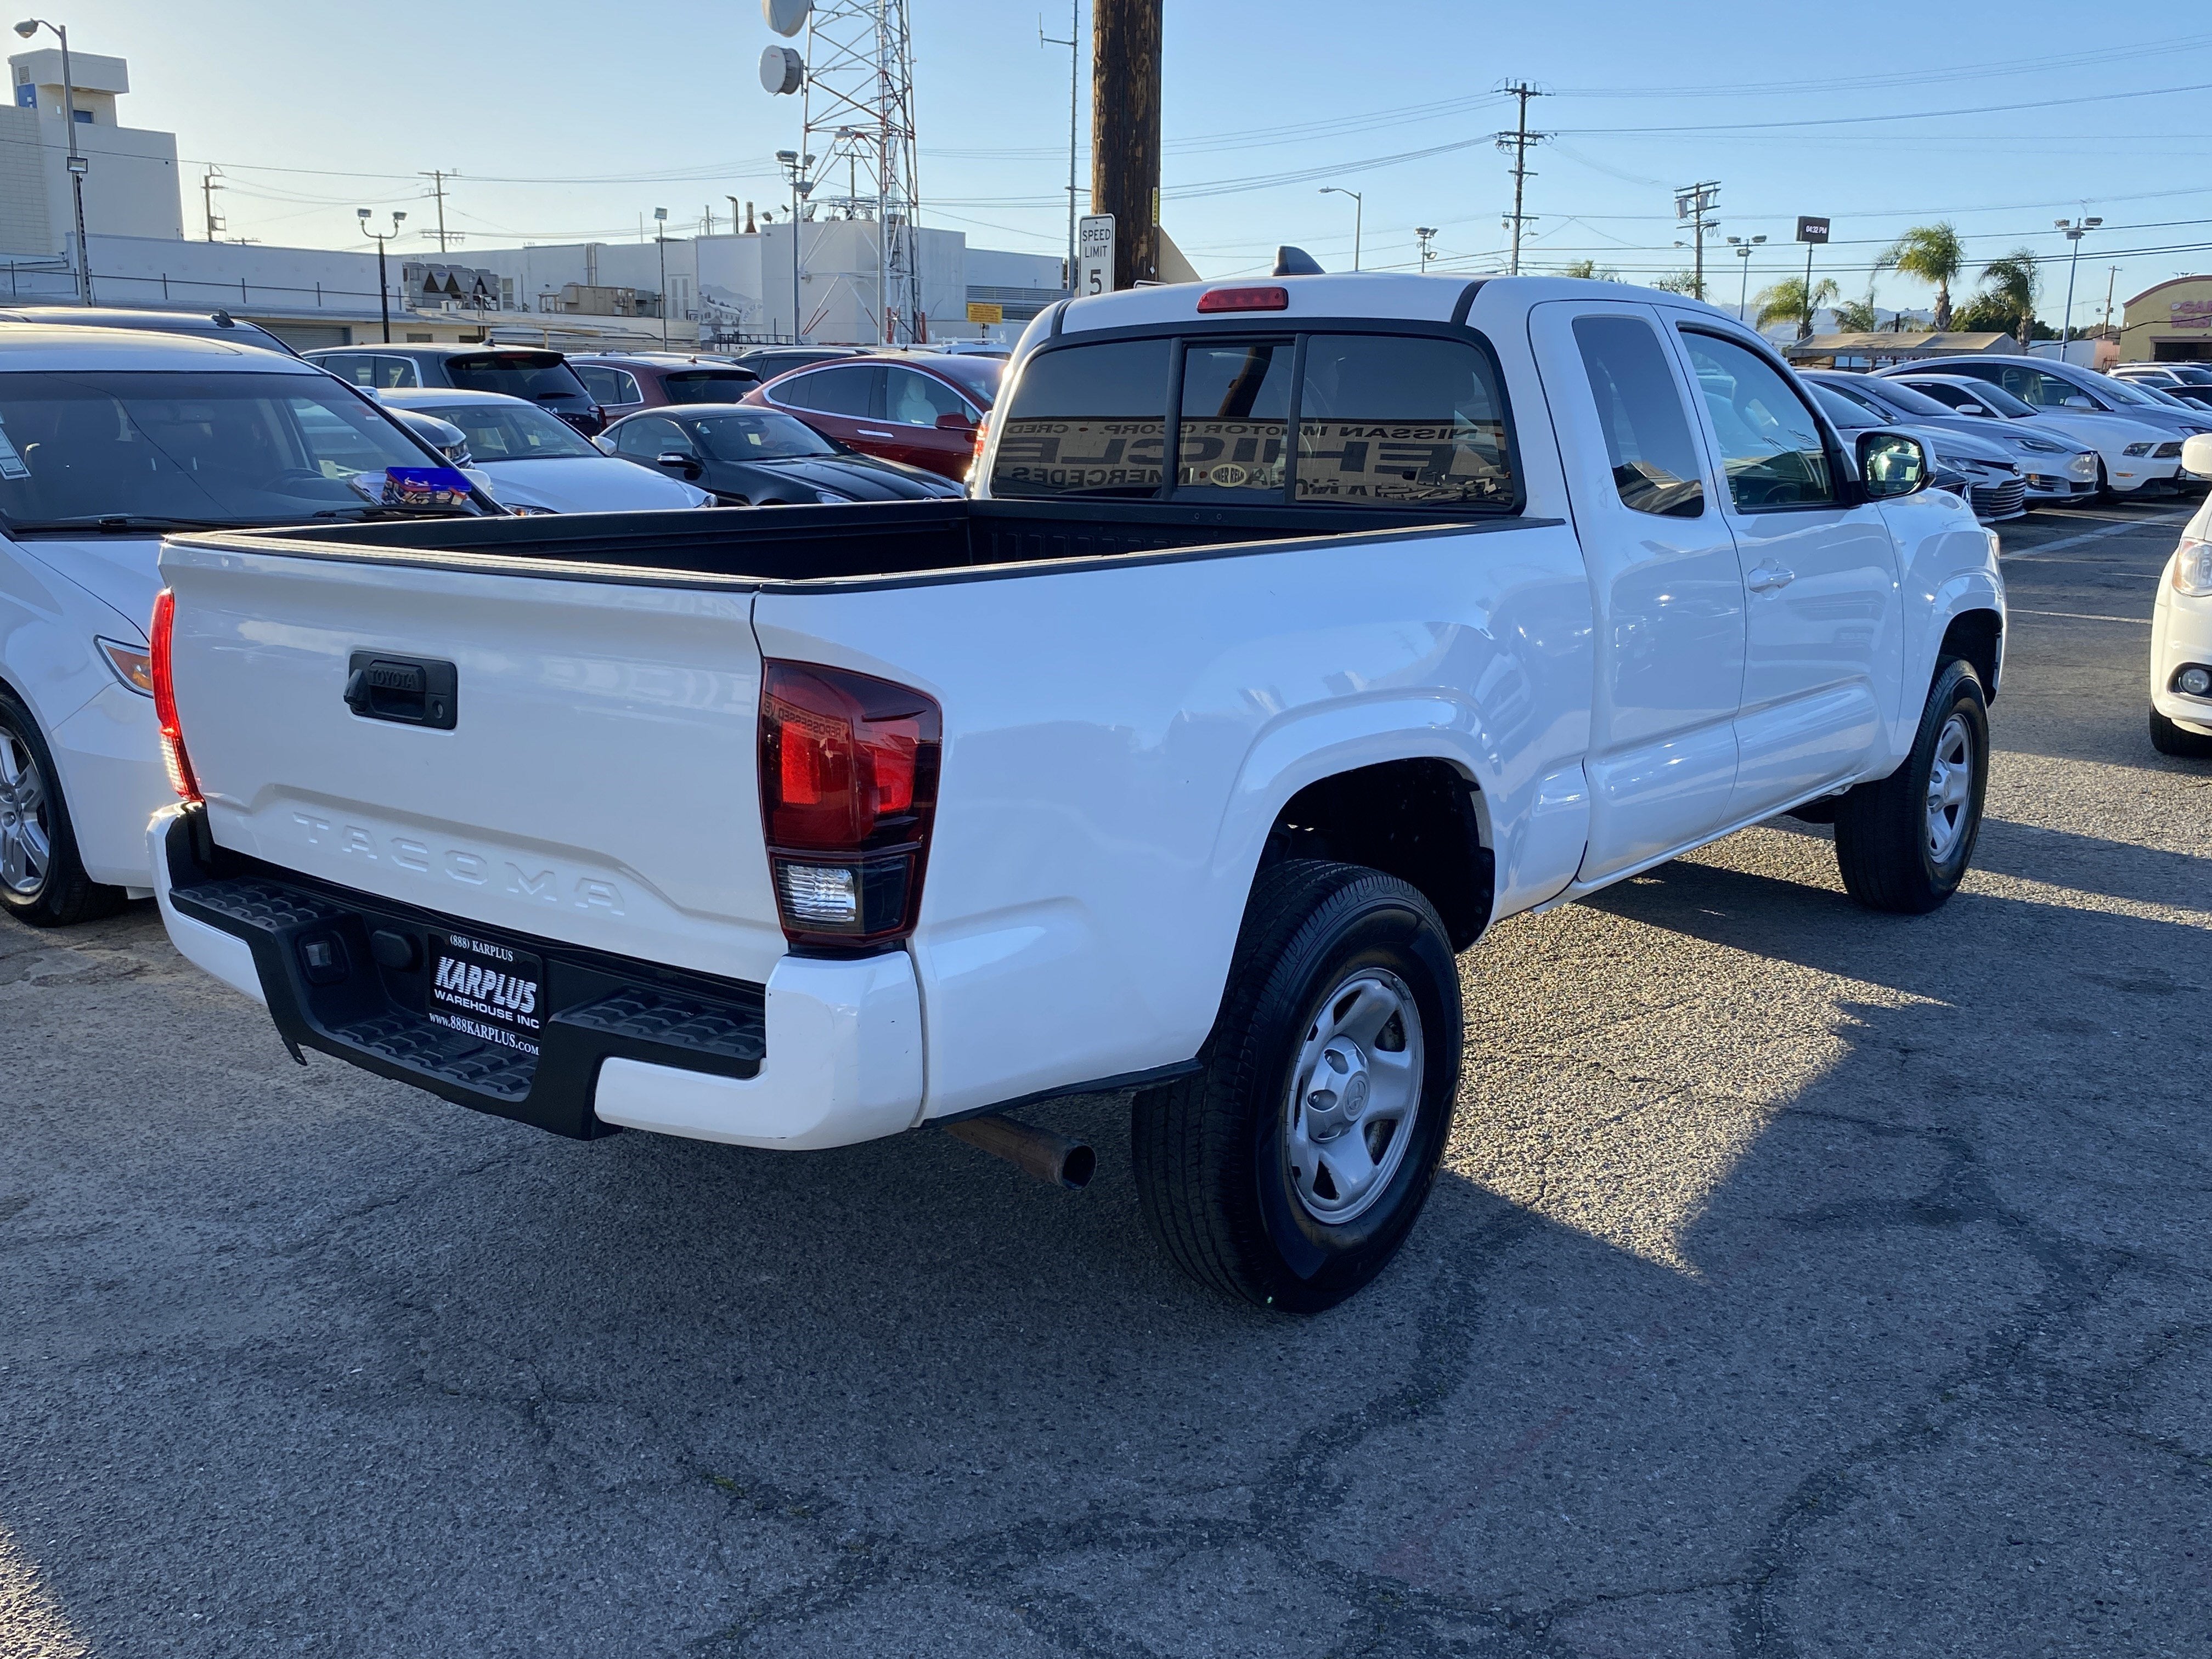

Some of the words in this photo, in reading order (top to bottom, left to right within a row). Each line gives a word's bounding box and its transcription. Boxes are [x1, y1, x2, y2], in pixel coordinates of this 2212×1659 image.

[1082, 229, 1111, 242] SPEED
[1085, 245, 1108, 258] LIMIT
[1090, 269, 1102, 296] 5
[369, 668, 416, 690] TOYOTA
[292, 811, 625, 916] TACOMA
[450, 934, 470, 949] (888)
[472, 940, 514, 962] KARPLUS
[434, 956, 537, 1014] KARPLUS
[434, 989, 514, 1021] WAREHOUSE
[517, 1015, 540, 1029] INC
[428, 1013, 540, 1056] www.888KARPLUS.COM
